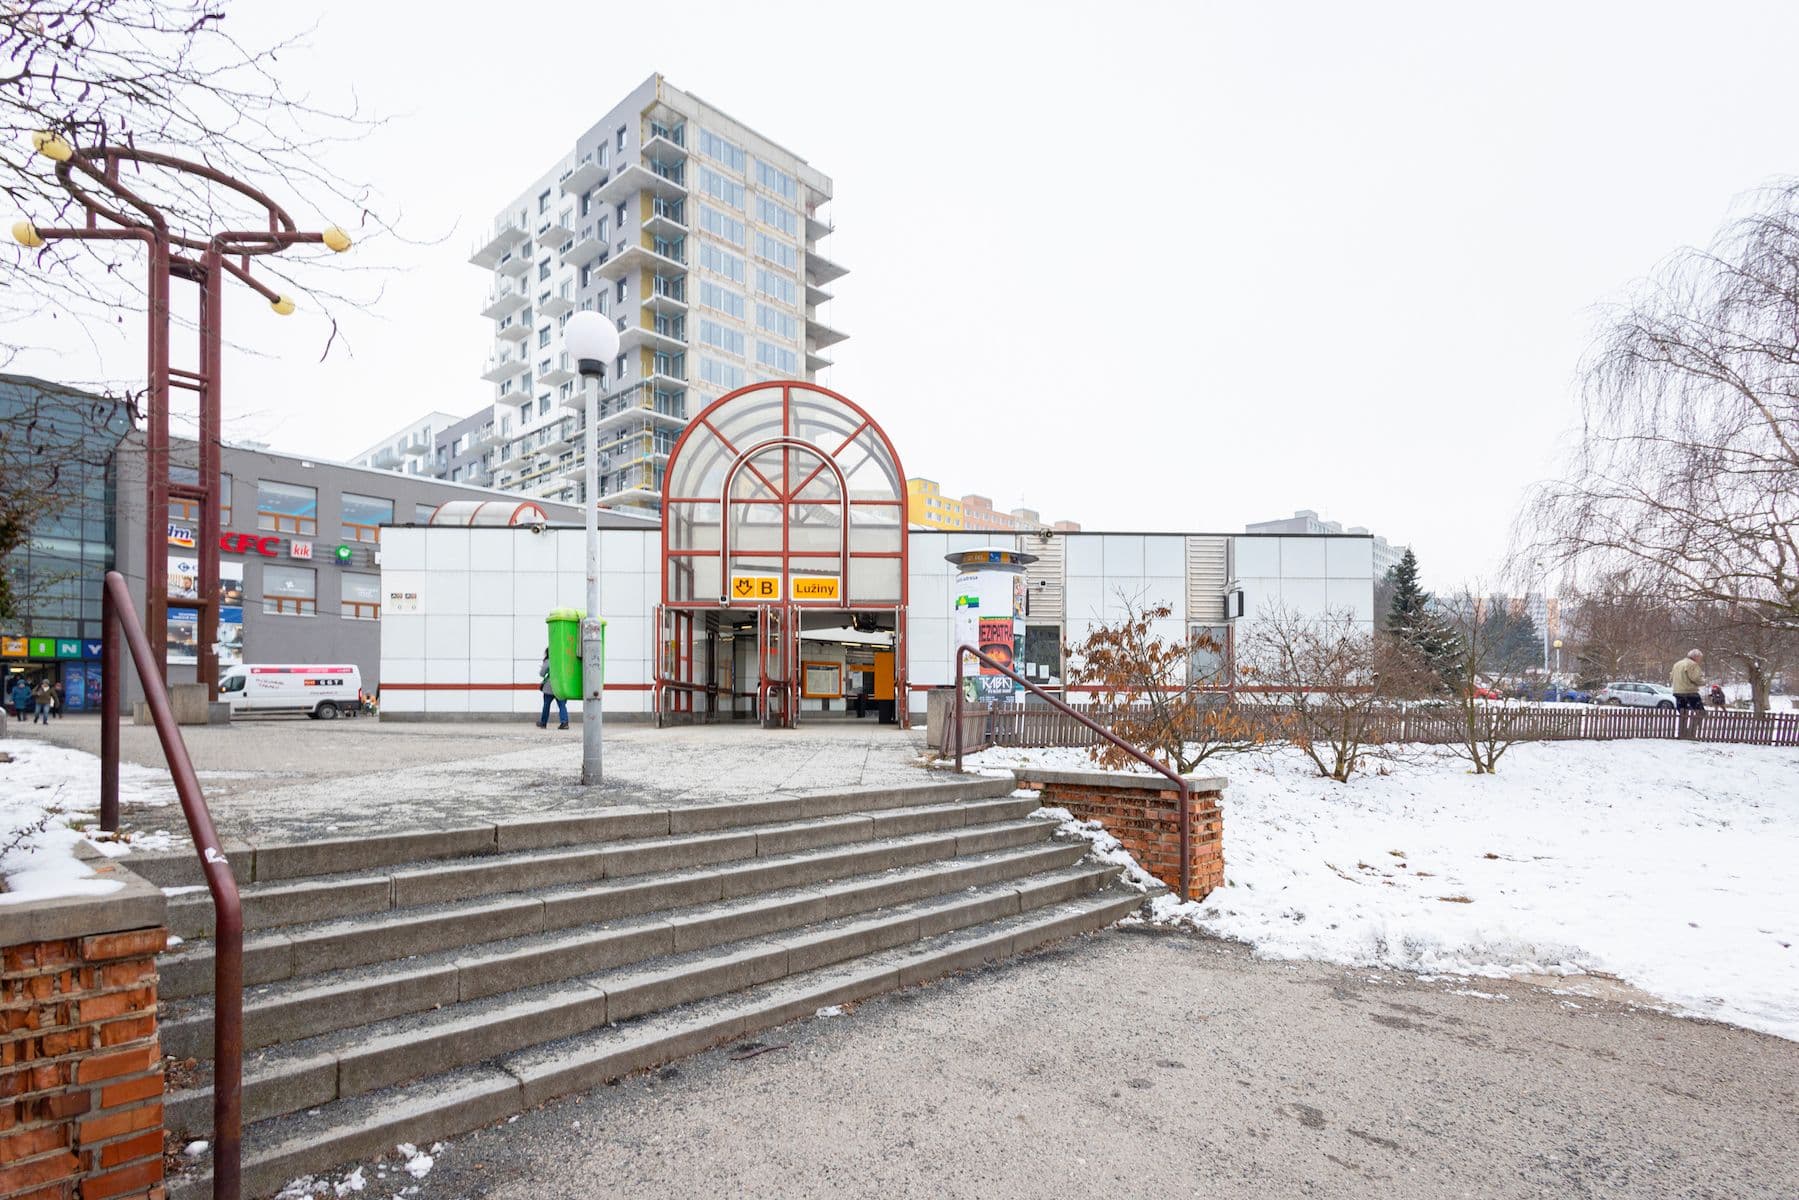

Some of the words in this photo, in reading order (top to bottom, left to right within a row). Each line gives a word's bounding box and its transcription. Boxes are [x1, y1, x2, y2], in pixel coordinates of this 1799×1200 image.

[219, 532, 280, 557] KFC
[293, 544, 310, 558] kik
[761, 581, 773, 595] B
[796, 582, 835, 597] Lužiny
